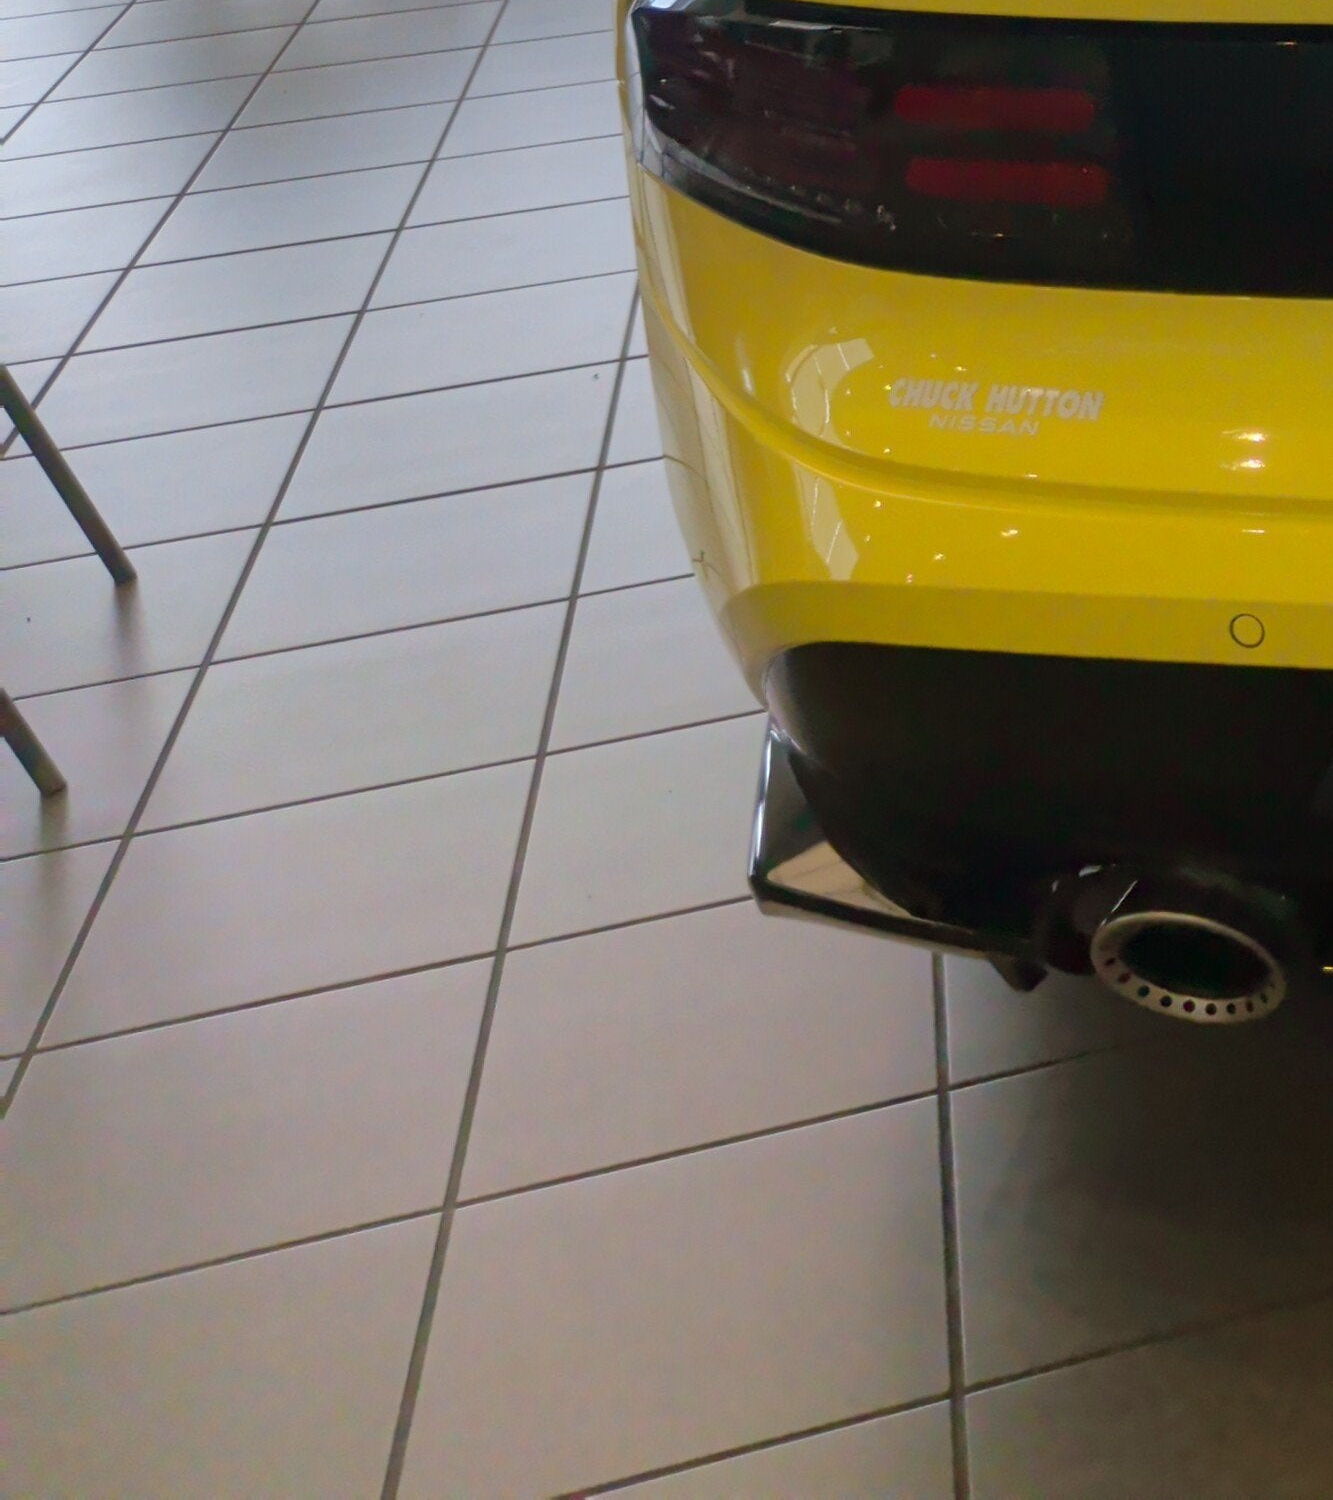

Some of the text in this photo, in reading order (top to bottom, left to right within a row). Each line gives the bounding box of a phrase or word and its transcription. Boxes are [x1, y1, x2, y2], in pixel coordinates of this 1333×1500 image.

[888, 377, 1105, 422] CHUCK HUTTON
[928, 413, 1040, 436] NISSAN
